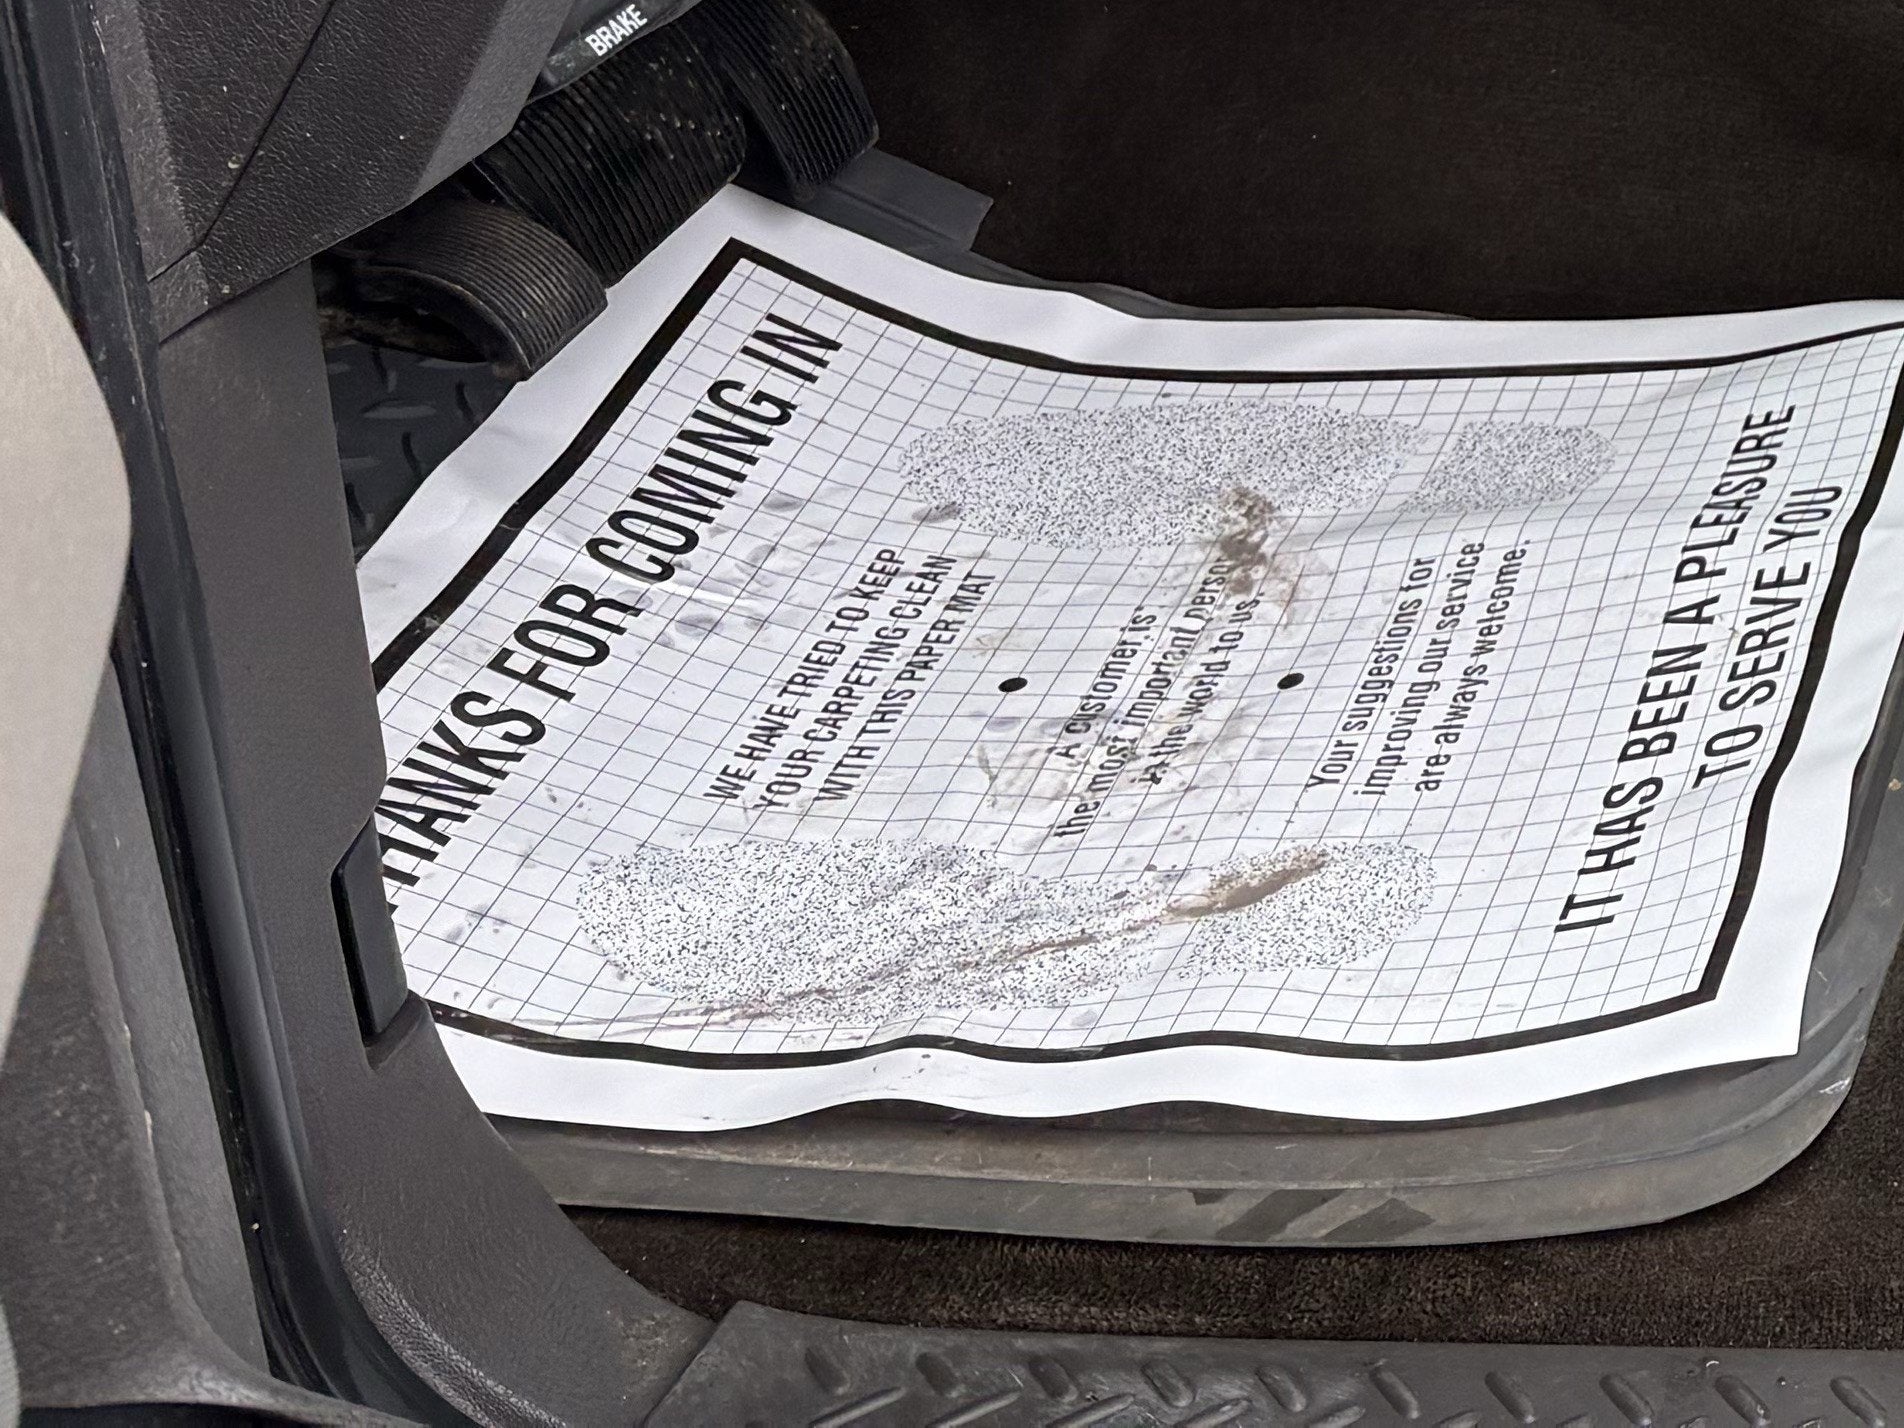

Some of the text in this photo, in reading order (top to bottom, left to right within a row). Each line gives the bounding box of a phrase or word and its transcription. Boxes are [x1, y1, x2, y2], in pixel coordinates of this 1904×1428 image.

[584, 3, 648, 56] BRAKE
[375, 312, 843, 915] HANKS FOR COMING IN
[703, 549, 905, 799] WE HAVE TRIED TO KEEP
[753, 555, 957, 808] YOUR CARPETING CLEAN
[813, 571, 995, 801] WITH THIS PAPER MAT
[1053, 801, 1101, 838] the
[1087, 735, 1138, 793] most
[1113, 627, 1201, 727] important
[1062, 640, 1142, 734] customer
[1148, 724, 1194, 758] the
[1177, 660, 1231, 717] world
[1209, 631, 1244, 653] to
[1230, 587, 1265, 623] us.
[1304, 558, 1435, 788] Your suggestions for
[1361, 542, 1485, 795] improving our service
[1414, 540, 1530, 792] are always welcome.
[1554, 405, 1795, 933] IT HAS BEEN A PLEASURE
[1693, 486, 1842, 788] TO SERVE YOU
